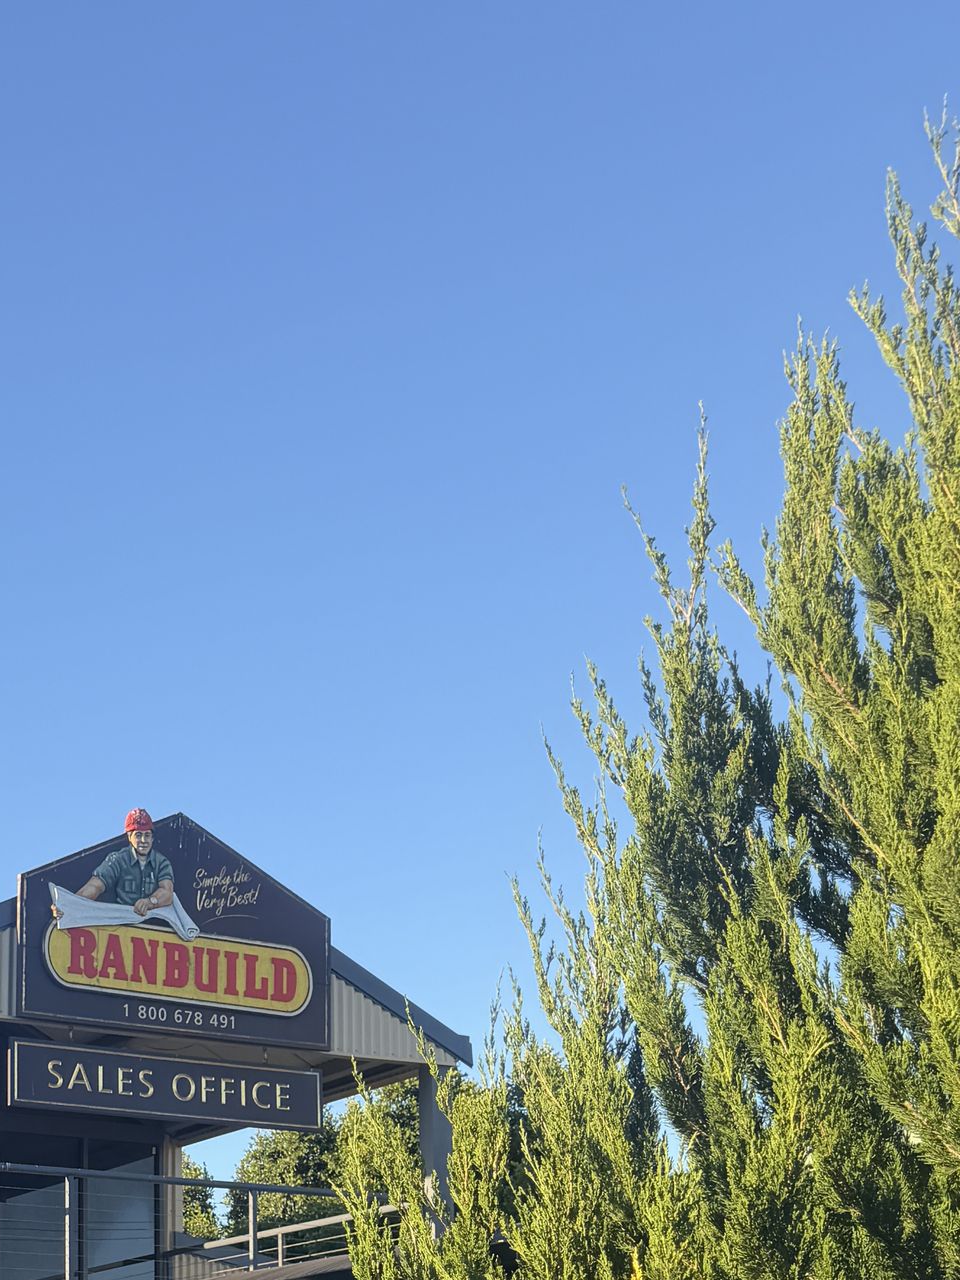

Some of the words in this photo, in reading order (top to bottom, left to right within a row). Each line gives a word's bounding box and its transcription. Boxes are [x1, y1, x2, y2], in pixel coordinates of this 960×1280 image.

[193, 868, 231, 893] Simply
[233, 866, 253, 882] the
[196, 891, 226, 915] Very
[227, 884, 261, 907] Best!
[67, 927, 297, 1003] RANBUILD
[123, 1004, 130, 1017] 1
[137, 1006, 167, 1022] 800
[174, 1009, 203, 1026] 678
[209, 1013, 237, 1029] 491
[47, 1059, 154, 1098] SALES
[171, 1073, 291, 1111] OFFICE
